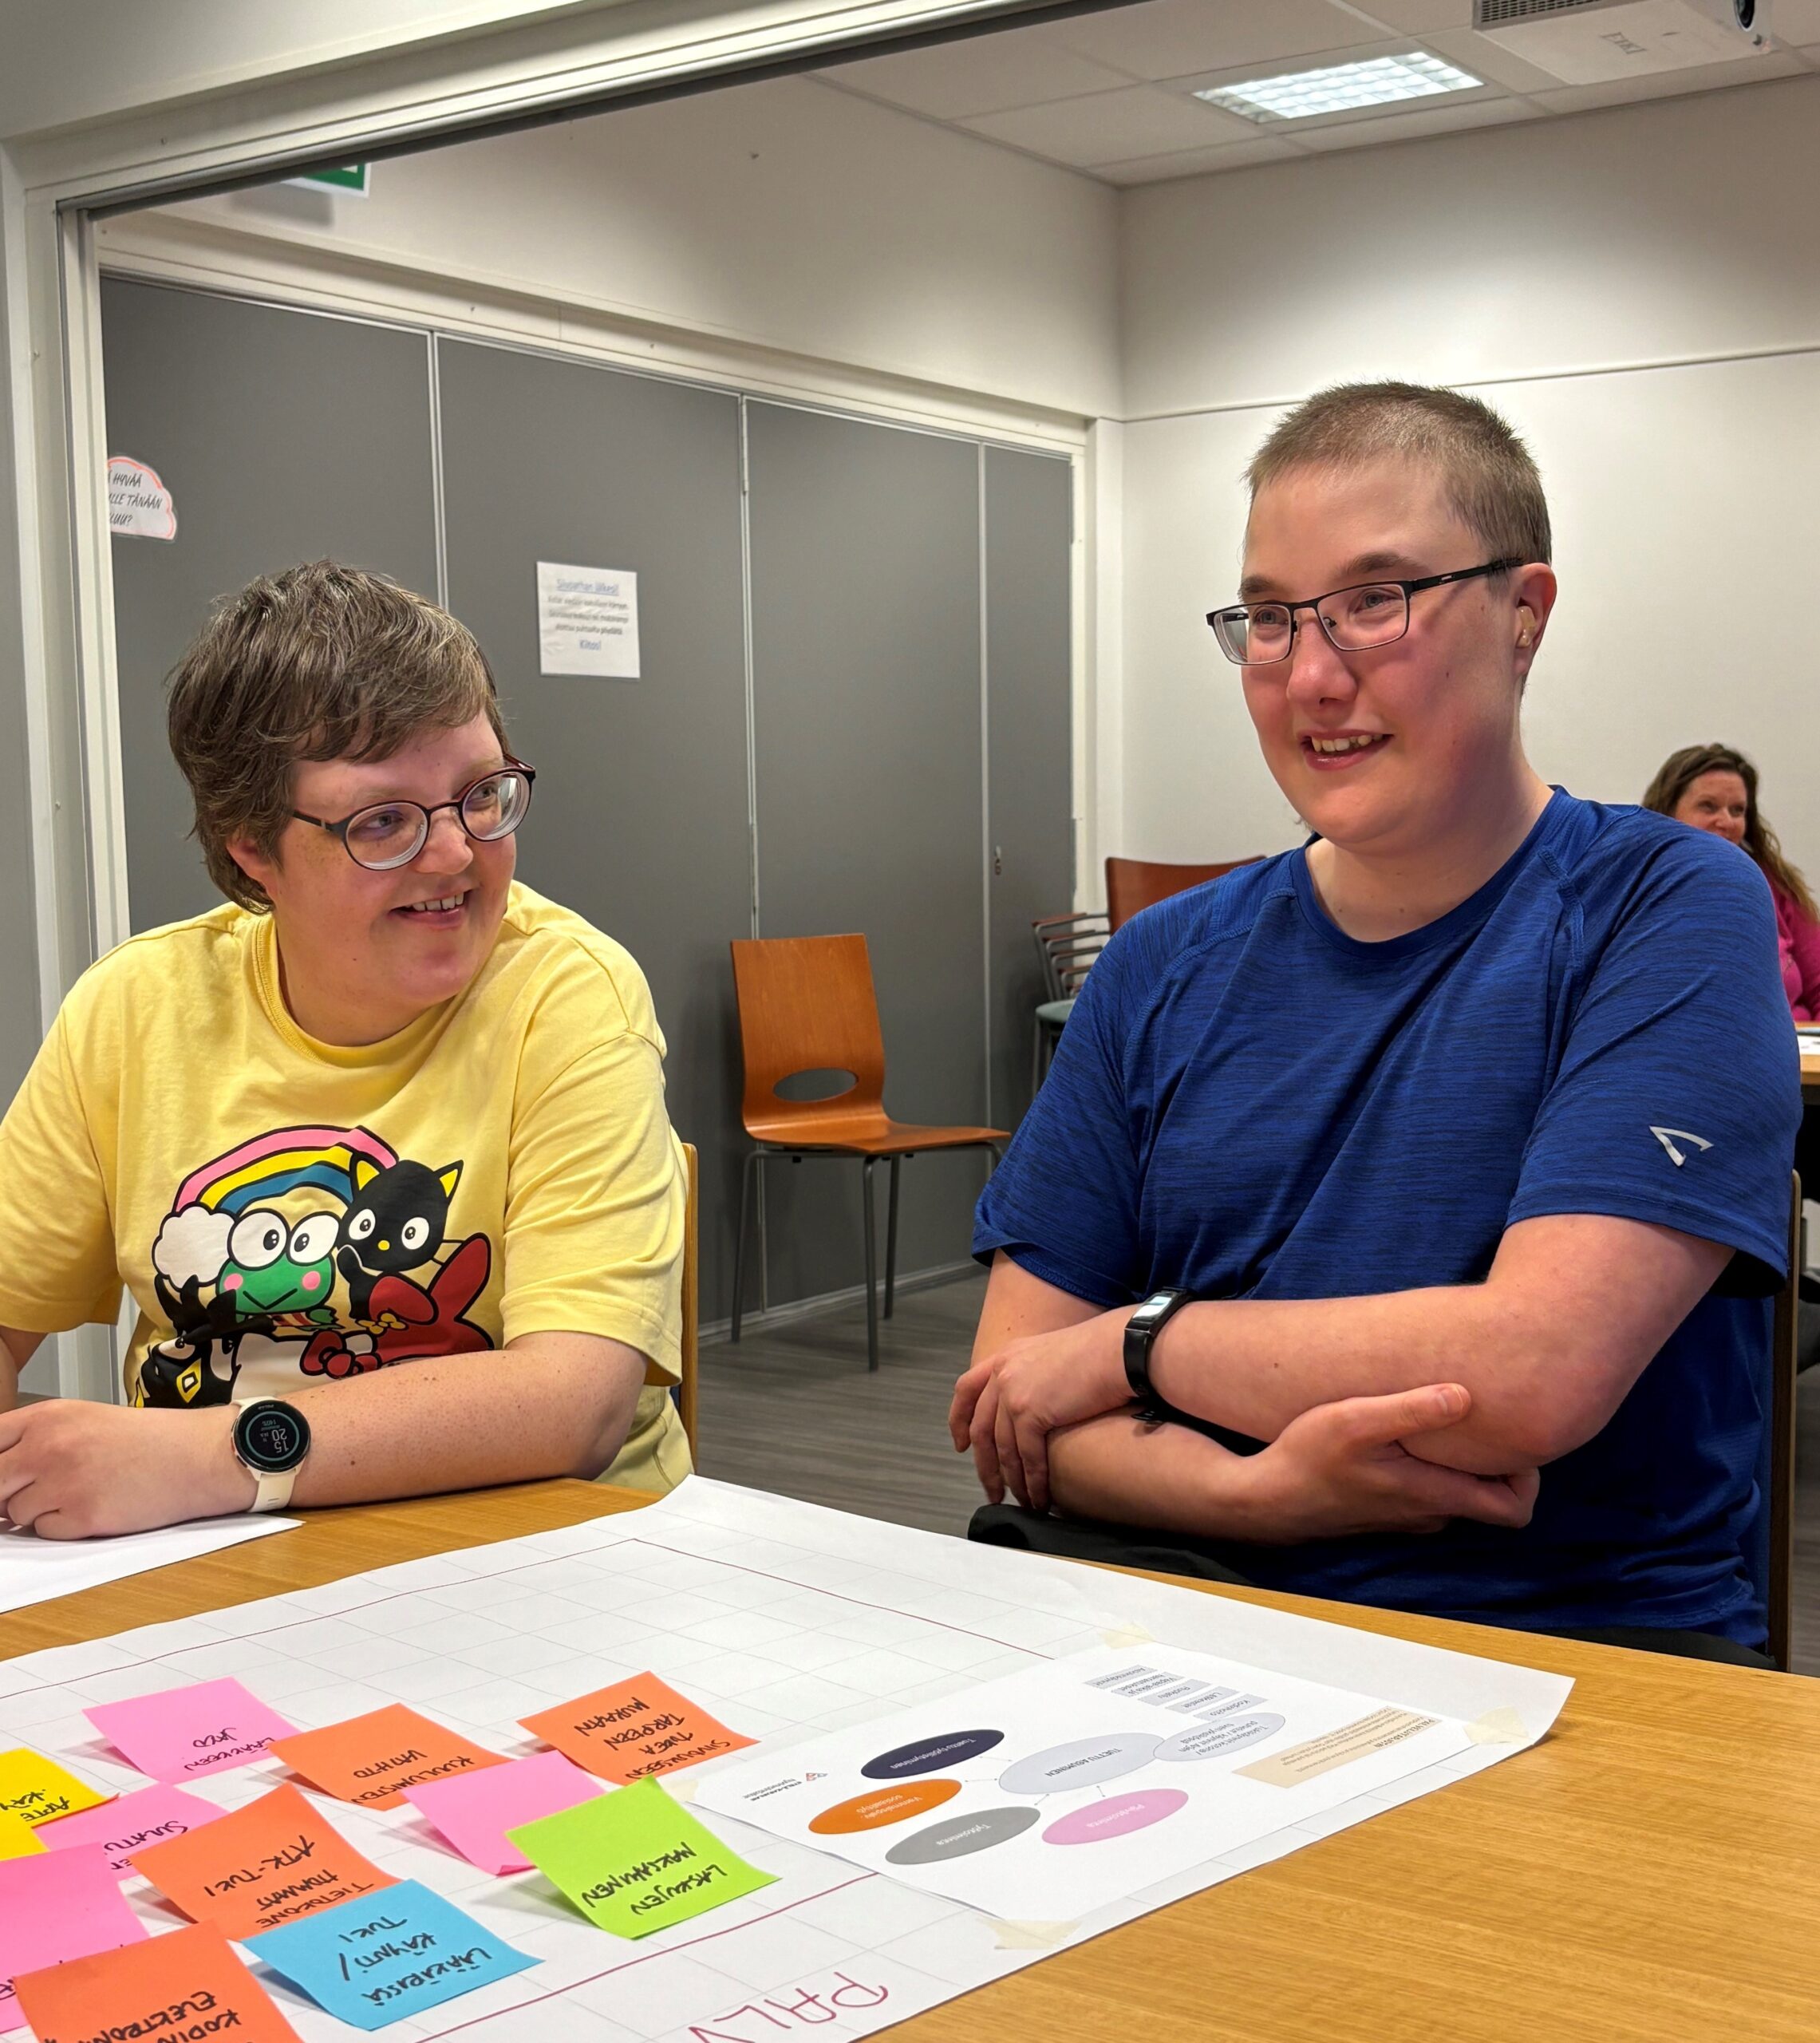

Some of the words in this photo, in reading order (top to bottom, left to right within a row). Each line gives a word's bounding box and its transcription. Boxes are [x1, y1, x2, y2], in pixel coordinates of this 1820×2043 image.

[109, 512, 133, 527] LUU?
[271, 1428, 287, 1441] 20
[274, 1440, 289, 1453] 15
[574, 1697, 650, 1737] MUKAAN
[603, 1713, 685, 1751] TARPEEN
[193, 1727, 238, 1748] JAKO
[1088, 1748, 1123, 1762] TUETTU
[350, 1756, 474, 1804] KUULUMISTEN
[353, 1749, 428, 1778] VAIHTO
[1044, 1758, 1089, 1777] ASUMINEN
[103, 1820, 188, 1855] SULATU
[203, 1835, 315, 1897] ATK-TUKI
[581, 1841, 697, 1908] MAKSAMINEN
[255, 1883, 375, 1928] TIETOKONE
[256, 1869, 338, 1911] HOMMAT
[630, 1864, 728, 1915] LASKUJEN
[338, 1916, 409, 1943] TUKI
[361, 1947, 492, 2006] LÄÄKÄRISSÄ
